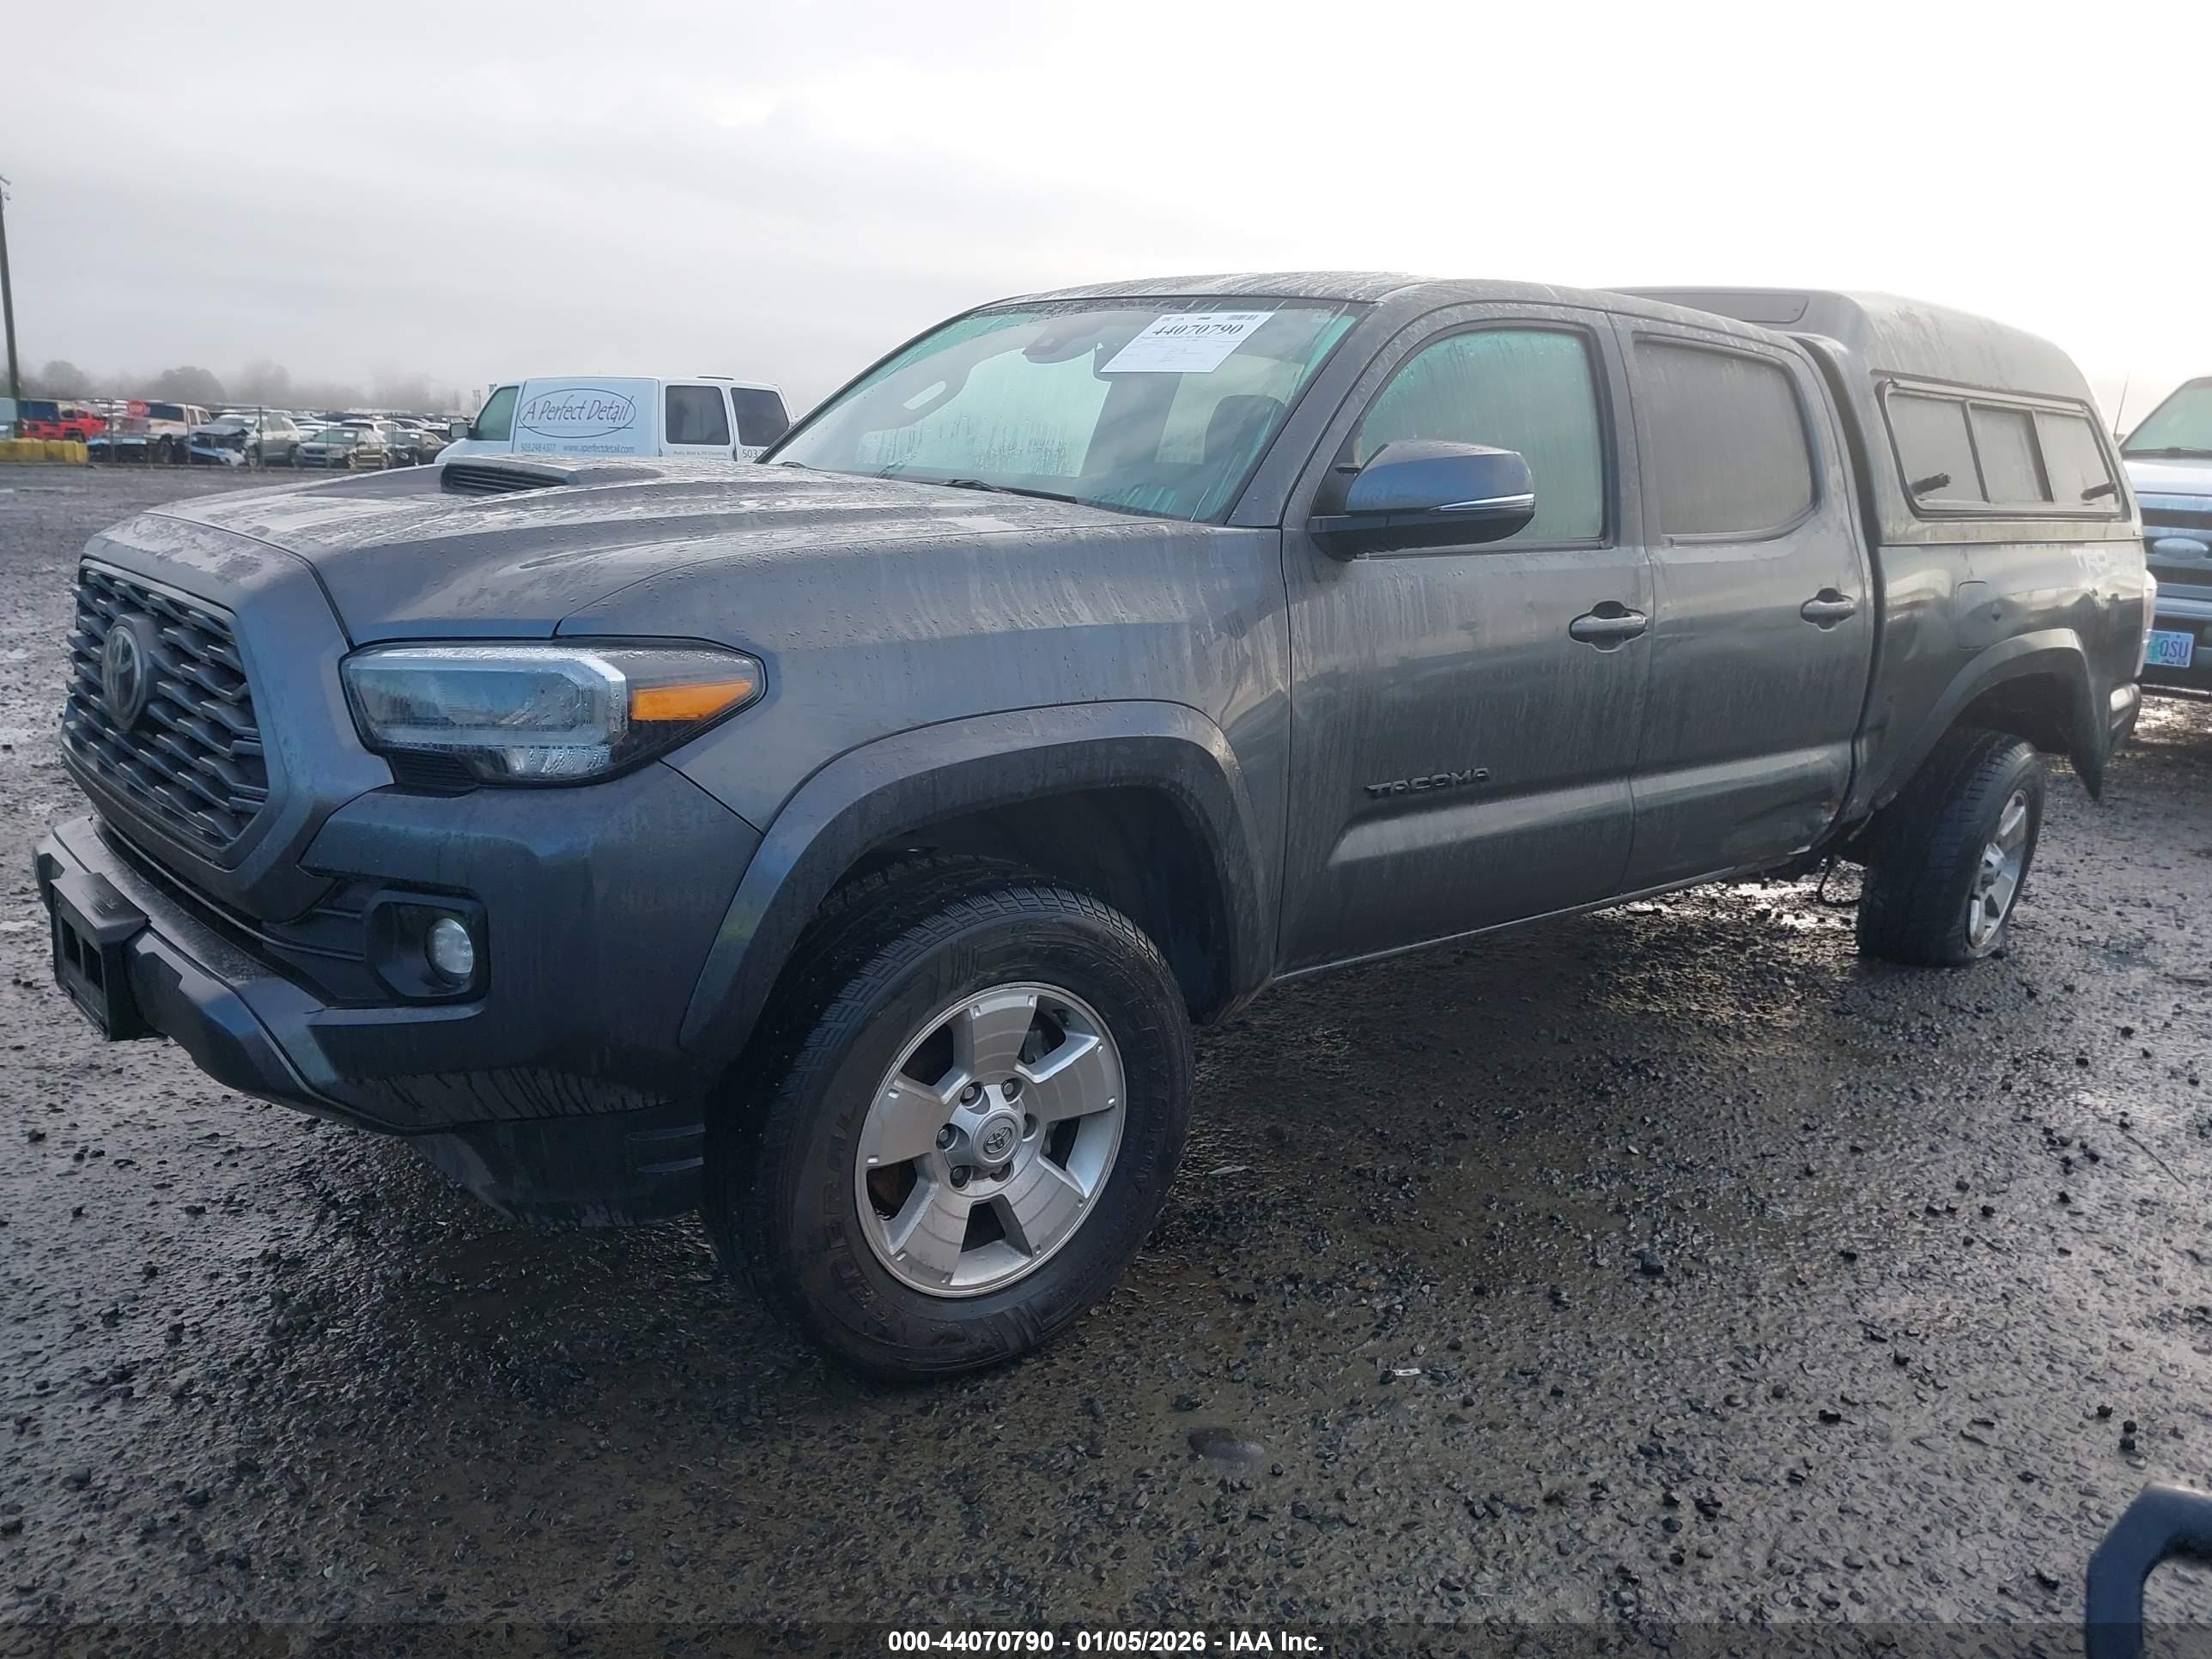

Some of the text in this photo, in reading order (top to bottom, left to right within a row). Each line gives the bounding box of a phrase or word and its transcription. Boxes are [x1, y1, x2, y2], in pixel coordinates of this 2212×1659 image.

[1152, 324, 1244, 336] 44070790
[523, 393, 635, 424] A Perfect Detail
[1365, 768, 1490, 797] TACOMA
